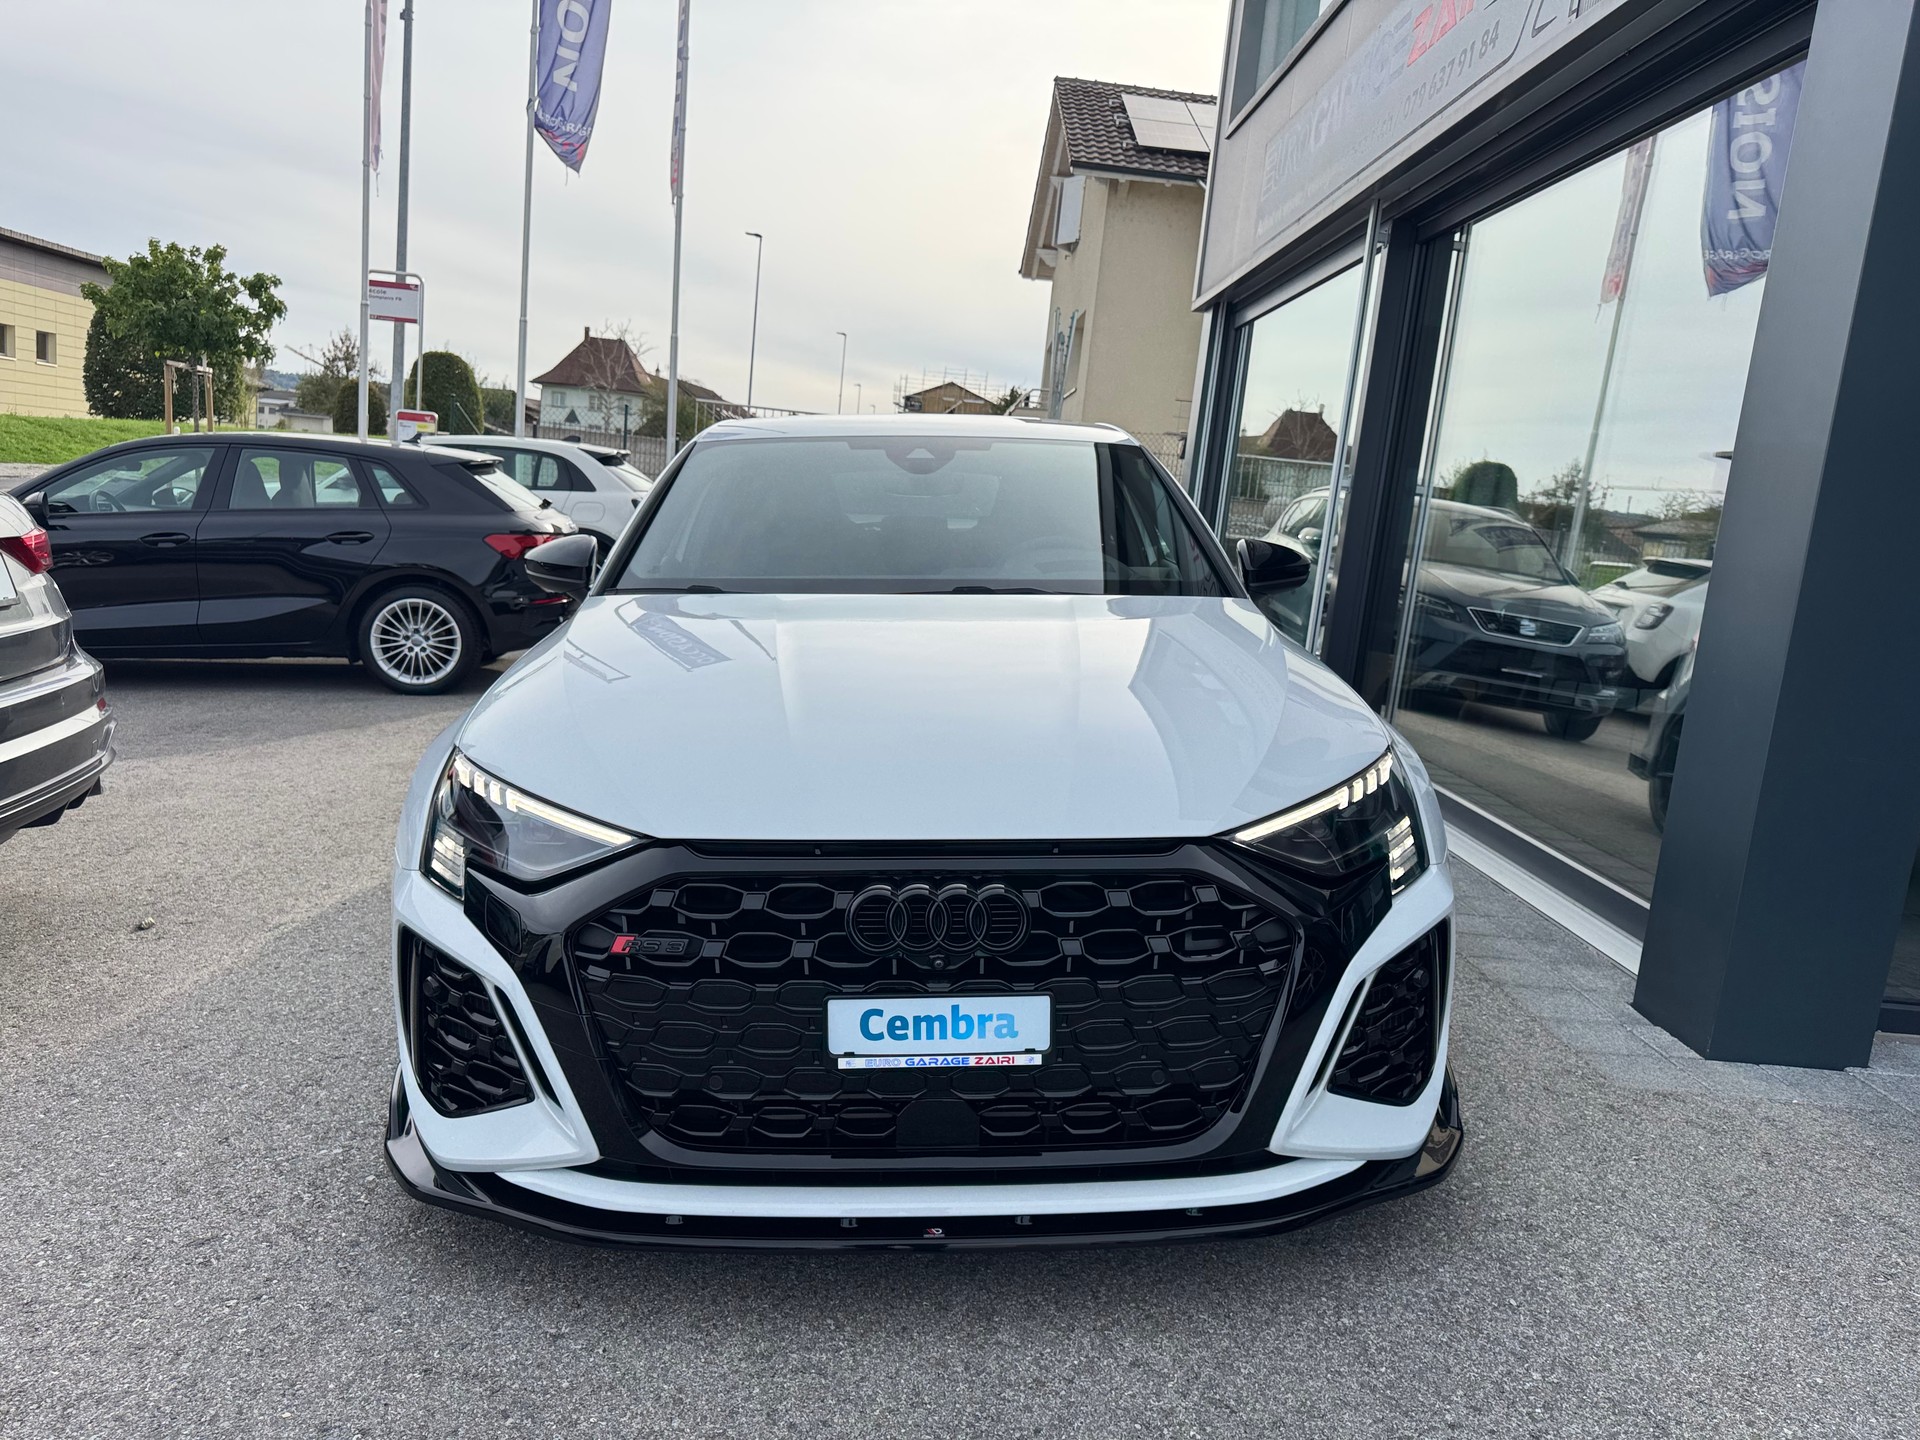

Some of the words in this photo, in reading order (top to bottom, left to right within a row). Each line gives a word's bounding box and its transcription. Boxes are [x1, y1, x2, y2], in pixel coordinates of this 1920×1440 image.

[553, 0, 592, 92] ON
[1407, 0, 1475, 67] ZA
[1403, 82, 1427, 120] 079
[1428, 58, 1456, 102] 637
[1457, 40, 1476, 77] 91
[1478, 19, 1500, 59] 84
[621, 940, 661, 953] RS
[666, 940, 685, 953] 3
[860, 1004, 1018, 1041] Cembra
[865, 1058, 901, 1067] EURO
[905, 1057, 970, 1066] GARAGE
[974, 1056, 1015, 1065] ZAIRI
